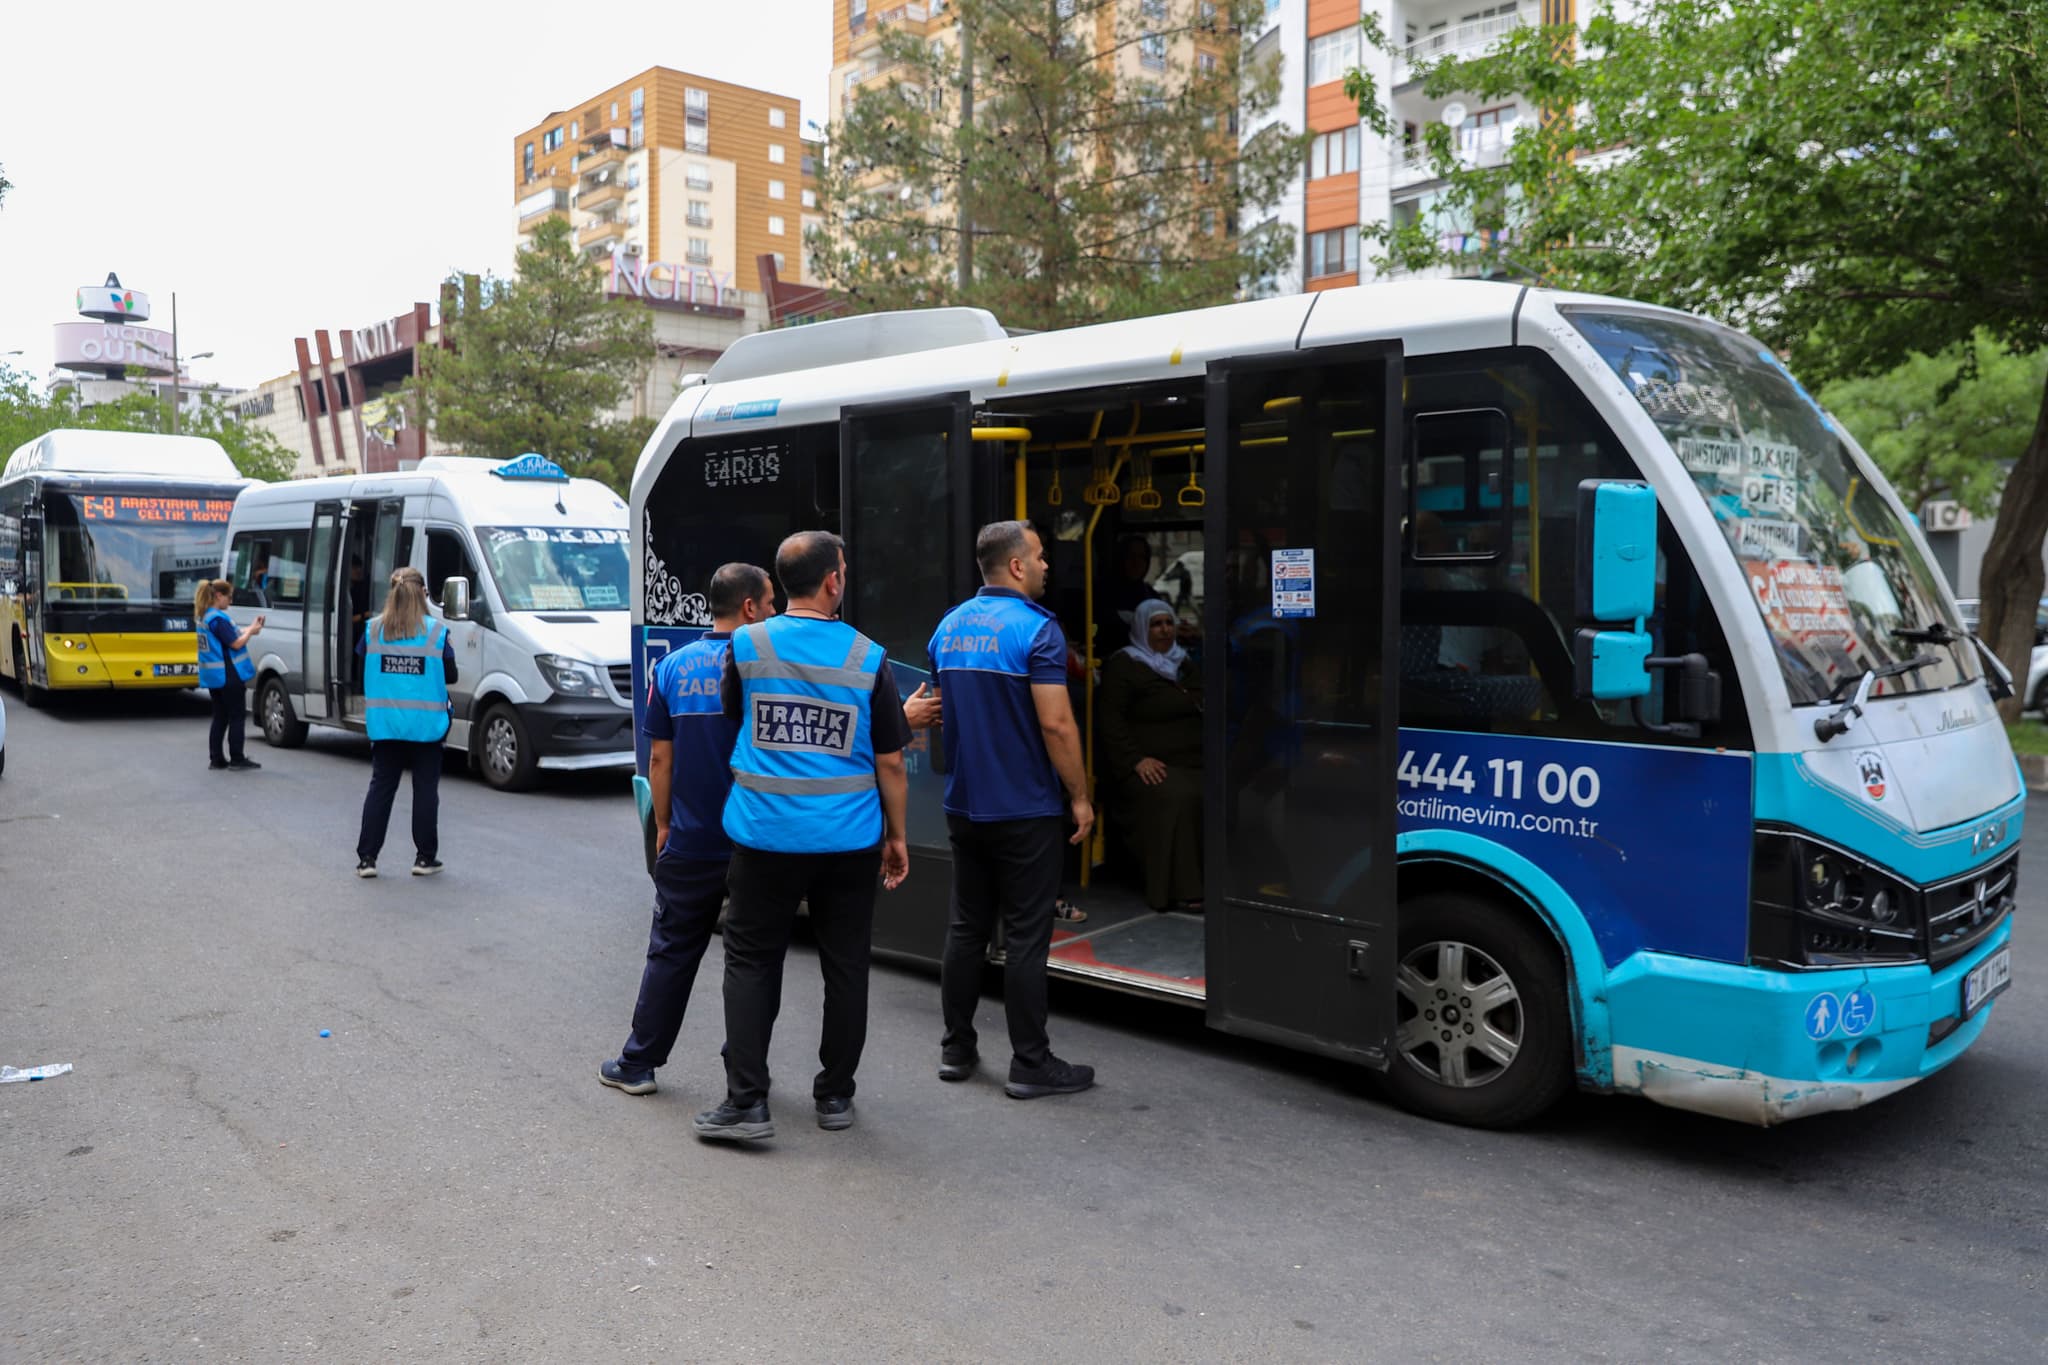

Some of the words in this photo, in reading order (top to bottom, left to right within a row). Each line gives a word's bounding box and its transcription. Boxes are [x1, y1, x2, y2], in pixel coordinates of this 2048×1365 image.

[611, 246, 732, 306] NCITY
[103, 325, 160, 342] NCITY
[351, 317, 398, 362] NCITY
[84, 496, 115, 519] E-8
[206, 501, 234, 512] HAS
[941, 636, 999, 653] ZABITA
[385, 656, 421, 666] TRAFİK
[678, 678, 718, 697] ZAB
[759, 704, 845, 731] TRAFİK
[758, 723, 843, 749] ZABITA
[1397, 750, 1476, 795] 444
[1488, 758, 1524, 800] 11
[1537, 762, 1601, 809] 00
